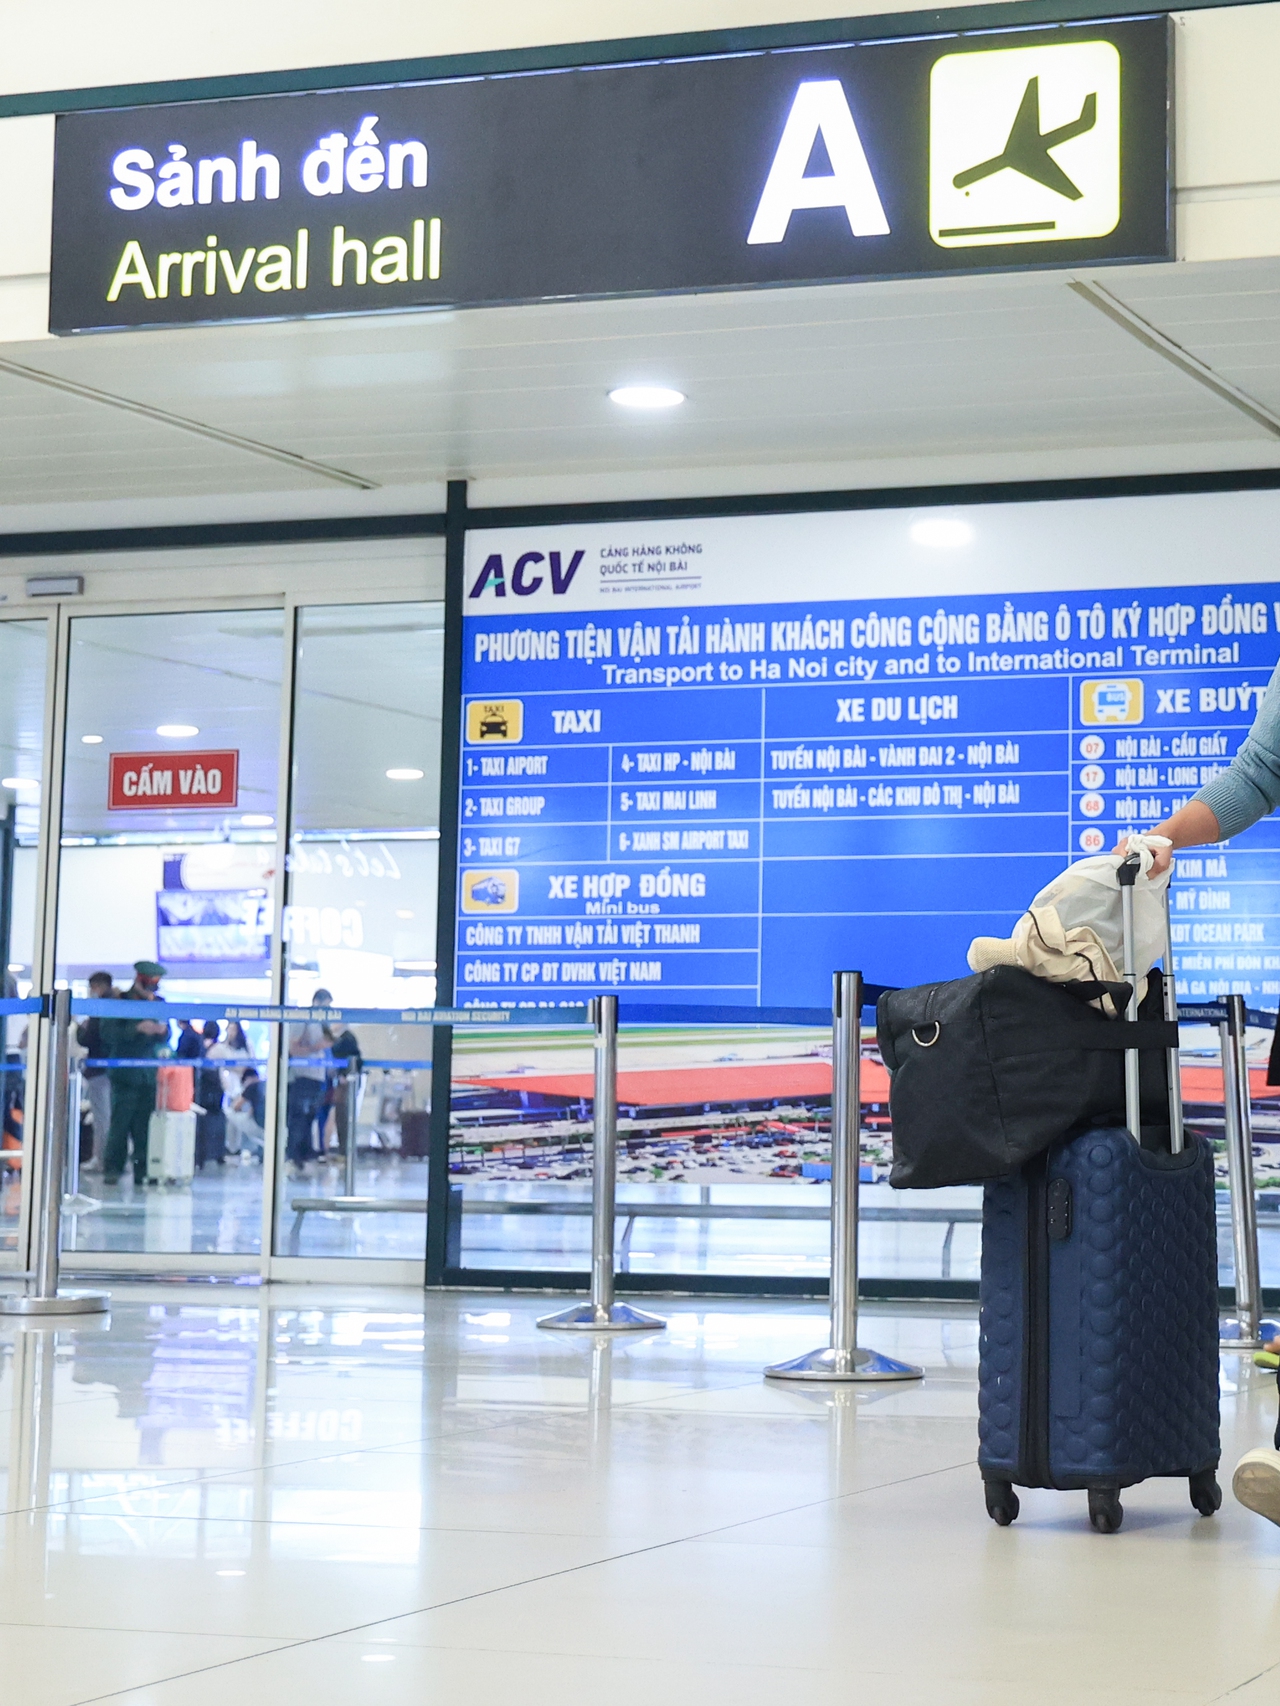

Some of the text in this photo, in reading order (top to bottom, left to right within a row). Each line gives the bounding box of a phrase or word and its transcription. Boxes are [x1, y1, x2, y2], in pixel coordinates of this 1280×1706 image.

[110, 115, 428, 210] Sảnh đến
[747, 79, 890, 244] A
[106, 217, 441, 302] Arrival hall
[469, 549, 585, 598] ACV
[600, 560, 688, 576] QUỐC TẾ NỘI BÀI
[474, 628, 560, 663] PHƯƠNG
[565, 622, 612, 665] TIỆN
[617, 621, 661, 663] VẬN
[666, 615, 699, 655] TẢI
[706, 617, 765, 654] HÀNH
[771, 614, 845, 651] KHÁCH
[851, 611, 912, 649] CÔNG
[918, 608, 980, 652] CỘNG
[986, 600, 1049, 644] BẰNG
[1055, 603, 1071, 641] Ô
[1077, 602, 1106, 640] TÔ
[1111, 600, 1142, 639] KÝ
[1148, 603, 1196, 643] HỢP
[1201, 593, 1268, 635] ĐỒNG
[601, 642, 1239, 687] Transport to Ha Noi city and to International Terminal
[836, 695, 959, 725] XE DU LỊCH
[1156, 681, 1267, 713] XE BUÝT
[552, 709, 601, 734] TAXI
[771, 740, 1020, 773] TUYẾN NỘI BÀI VÀNH ĐAI 2 NỘI BÀI
[1085, 743, 1099, 753] 07
[1115, 735, 1138, 761] NỘI
[1140, 734, 1161, 757] BÀI
[1199, 730, 1228, 756] GIẤY
[480, 757, 505, 776] TAXI
[506, 755, 548, 776] AIPORT
[636, 753, 662, 772] TAXI
[663, 752, 680, 771] HP
[690, 747, 713, 775] NỘI
[714, 747, 736, 771] BÀI
[122, 762, 221, 797] CẤM VÀO
[1085, 772, 1098, 782] 17
[1115, 764, 1136, 790] NỘI
[1138, 764, 1158, 786] BÀI
[1167, 766, 1198, 786] LONG
[480, 797, 504, 817] TAXI
[506, 796, 545, 816] GROUP
[636, 791, 661, 811] TAXI
[663, 791, 687, 811] MAI
[688, 790, 717, 810] LINH
[772, 780, 1020, 812] TUYẾN NỘI BÀI CÁC KHU ĐÔ THỊ NỘI BÀI
[1086, 801, 1100, 811] 68
[1115, 795, 1161, 822] NỘI BÀI
[478, 837, 503, 856] TAXI
[504, 836, 520, 856] G7
[632, 831, 661, 851] XANH
[662, 831, 680, 850] SM
[681, 830, 725, 850] AIRPORT
[727, 829, 749, 849] TAXI
[1085, 834, 1100, 845] 86
[1176, 859, 1202, 878] KIM
[548, 866, 706, 902] XE HỢP ĐỒNG
[586, 901, 660, 915] Mini bus
[1198, 887, 1230, 910] ĐÌNH
[466, 919, 701, 949] CÔNG TY TNHH VẬN TẢI VIỆT THANH
[1193, 923, 1232, 942] OCEAN
[1233, 923, 1265, 942] PARK
[464, 959, 500, 983] CÔNG
[503, 963, 520, 982] TY
[521, 962, 540, 982] CP
[561, 962, 596, 981] DVHK
[599, 958, 627, 986] VIỆT
[630, 961, 661, 981] NAM
[1190, 980, 1206, 994] GA
